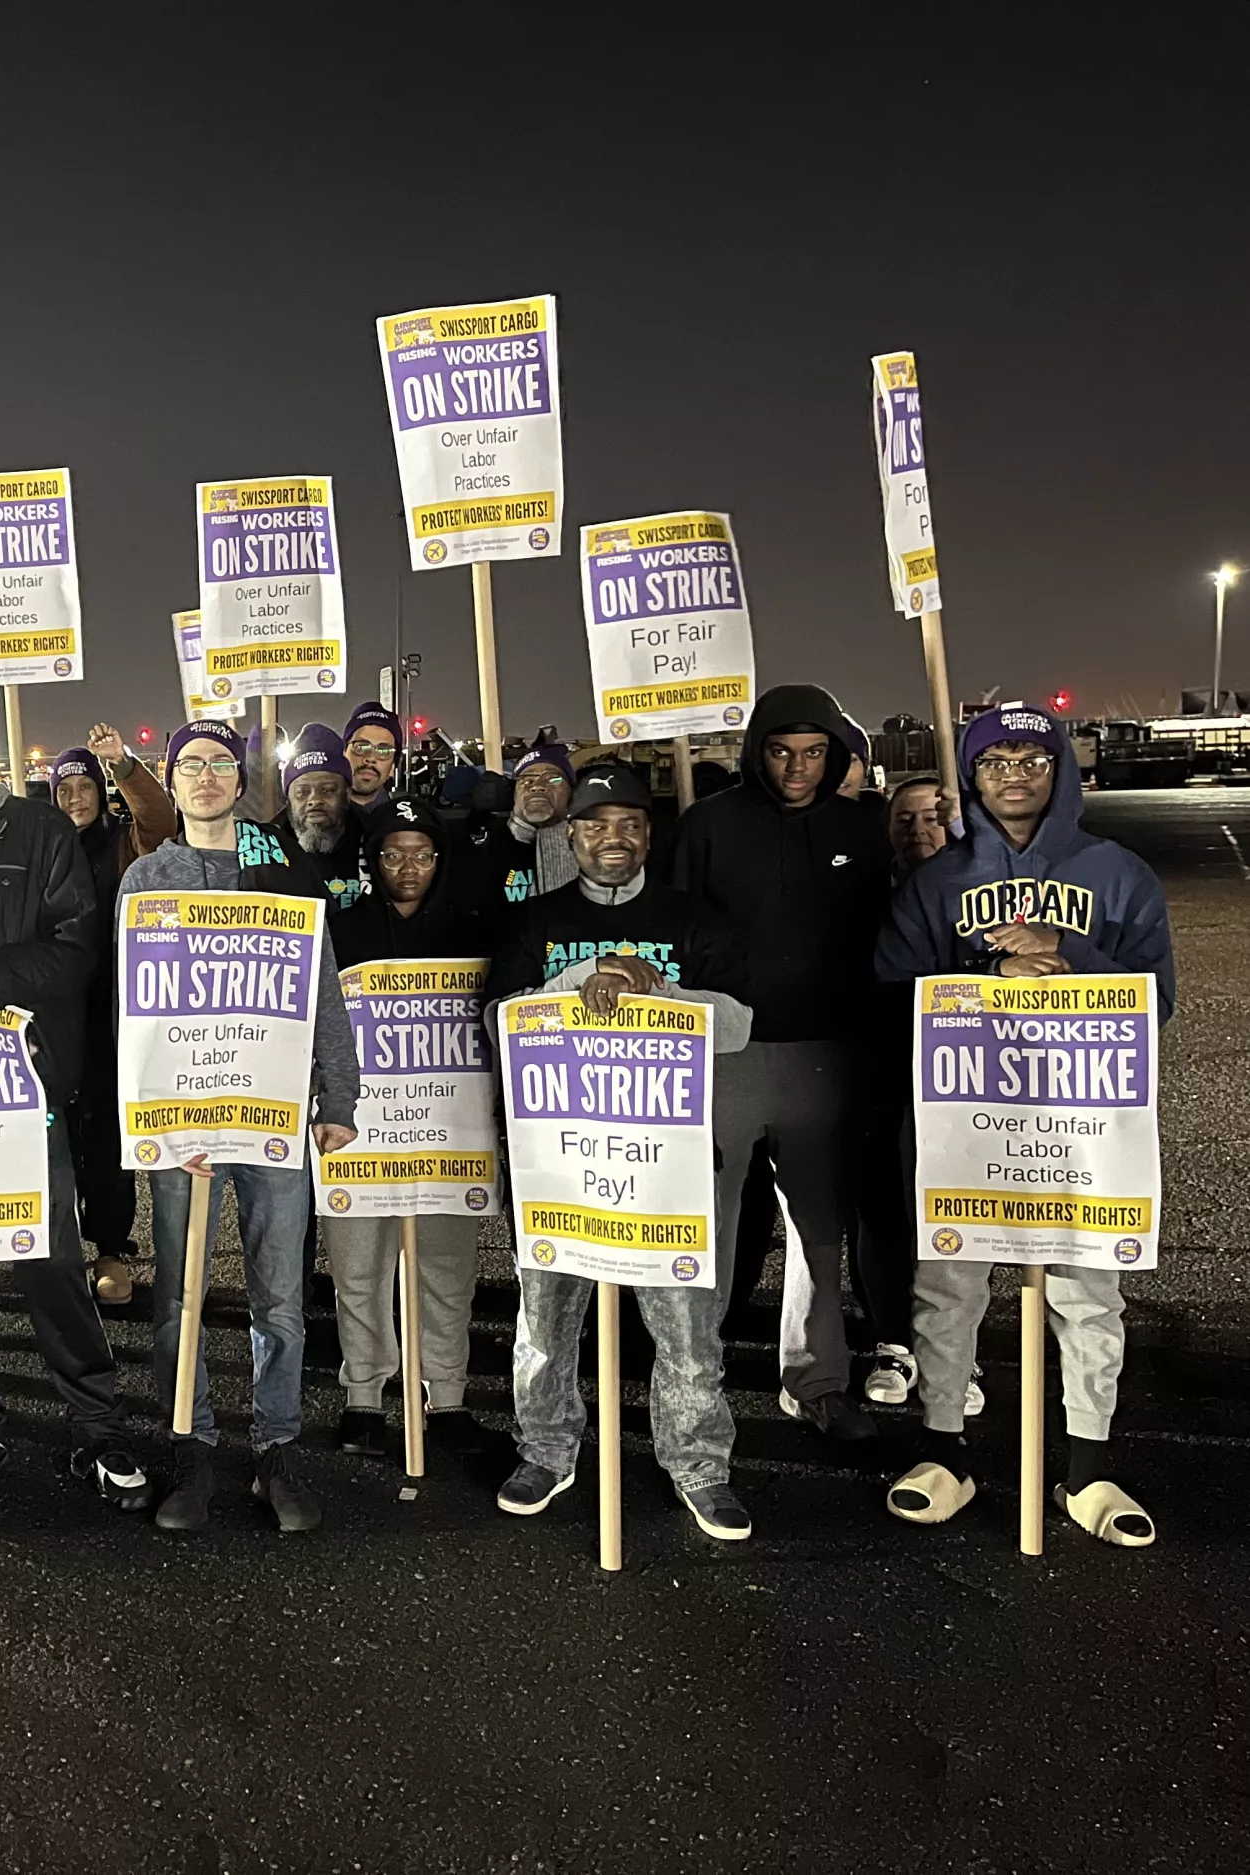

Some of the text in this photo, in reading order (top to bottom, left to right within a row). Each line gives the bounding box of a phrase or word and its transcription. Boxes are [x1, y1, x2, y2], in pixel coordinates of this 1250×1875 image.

[440, 311, 538, 337] SWISSPORT CARGO
[398, 347, 437, 362] RISING
[443, 339, 539, 366] WORKERS
[403, 364, 541, 422] ON STRIKE
[241, 488, 322, 506] SWISSPORT CARGO
[905, 483, 927, 506] For
[421, 501, 547, 531] PROTECT WORKERS' RIGHTS!
[212, 531, 329, 576] ON STRIKE
[639, 547, 728, 569] WORKERS
[600, 567, 735, 617] ON STRIKE
[631, 622, 717, 648] For Fair
[213, 647, 334, 670] PROTECT WORKERS' RIGHTS!
[654, 651, 697, 676] Pay!
[188, 904, 305, 930] SWISSPORT CARGO
[956, 877, 1093, 937] JORDAN
[137, 932, 179, 943] RISING
[187, 934, 301, 959] WORKERS
[548, 941, 673, 962] AIRPORT
[136, 960, 300, 1012] ON STRIKE
[370, 972, 482, 991] SWISSPORT CARGO
[370, 999, 480, 1019] WORKERS
[992, 988, 1136, 1010] SWISSPORT CARGO
[648, 1009, 694, 1031] CARGO
[933, 1018, 982, 1028] RISING
[992, 1020, 1136, 1042] WORKERS
[168, 1024, 268, 1043] Over Unfair
[519, 1035, 564, 1047] RISING
[192, 1048, 238, 1066] Labor
[375, 1023, 482, 1068] STRIKE
[572, 1037, 692, 1061] WORKERS
[176, 1072, 252, 1090] Practices
[932, 1046, 1137, 1100] ON STRIKE
[521, 1063, 693, 1118] ON STRIKE
[135, 1105, 290, 1128] PROTECT WORKERS' RIGHTS!
[972, 1112, 1106, 1136] Over Unfair
[560, 1131, 663, 1163] For Fair
[1006, 1140, 1072, 1158] Labor
[328, 1159, 487, 1179] PROTECT WORKERS' RIGHTS!
[987, 1163, 1092, 1184] Practices
[584, 1170, 635, 1206] Pay!
[934, 1198, 1142, 1226] PROTECT WORKERS' RIGHTS!
[532, 1210, 697, 1244] PROTECT WORKERS' RIGHTS!
